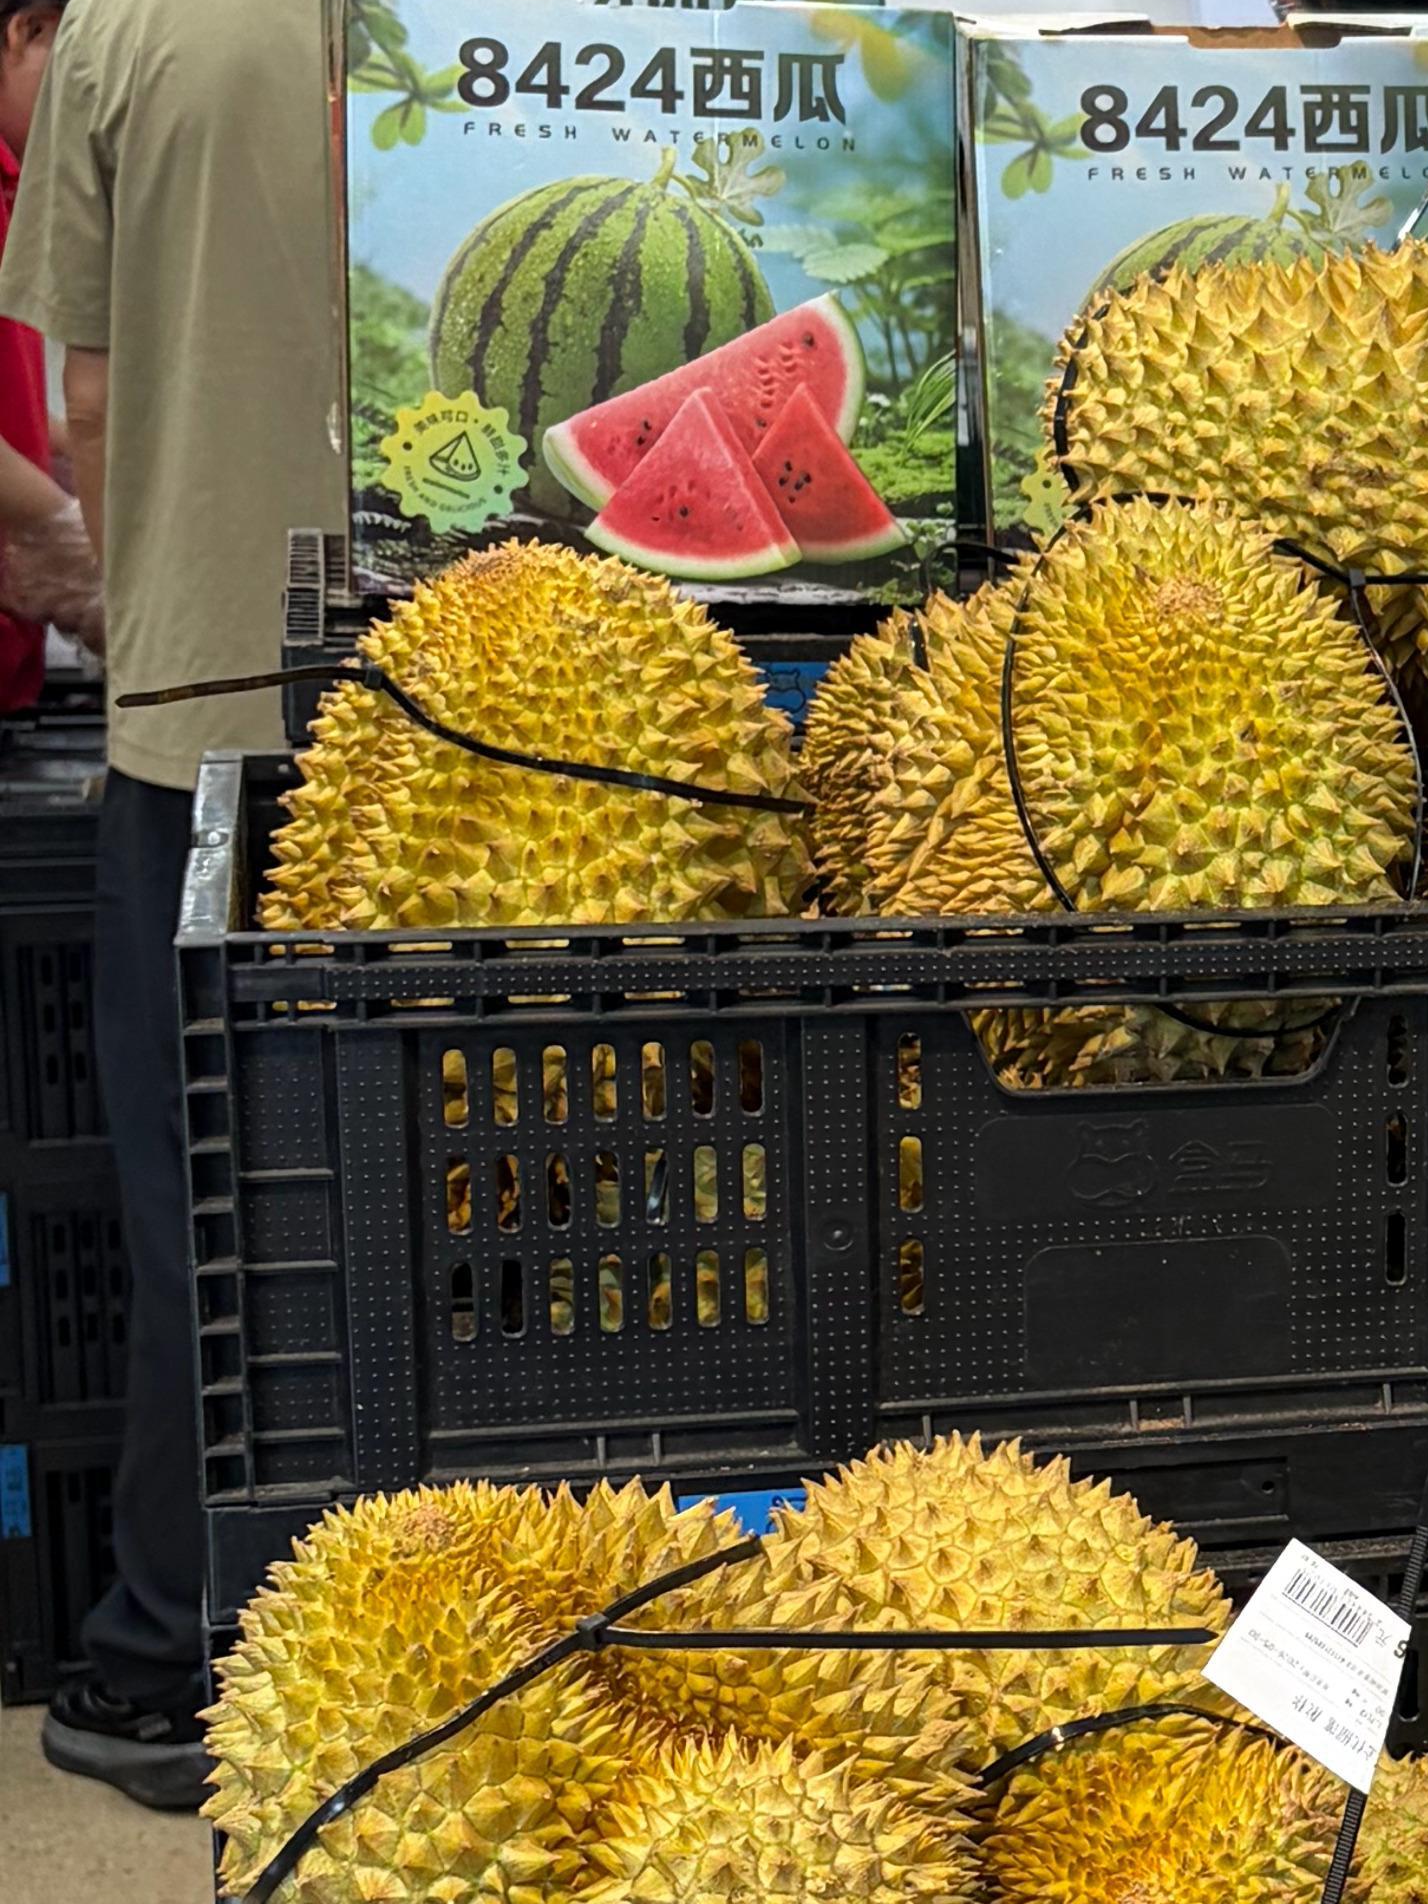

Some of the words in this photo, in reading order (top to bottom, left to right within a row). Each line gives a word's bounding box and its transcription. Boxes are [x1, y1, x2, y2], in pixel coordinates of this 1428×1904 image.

[457, 37, 848, 125] 8424西瓜
[462, 121, 579, 141] FRESH
[612, 127, 858, 153] WATERMELON
[1087, 166, 1196, 182] FRESH
